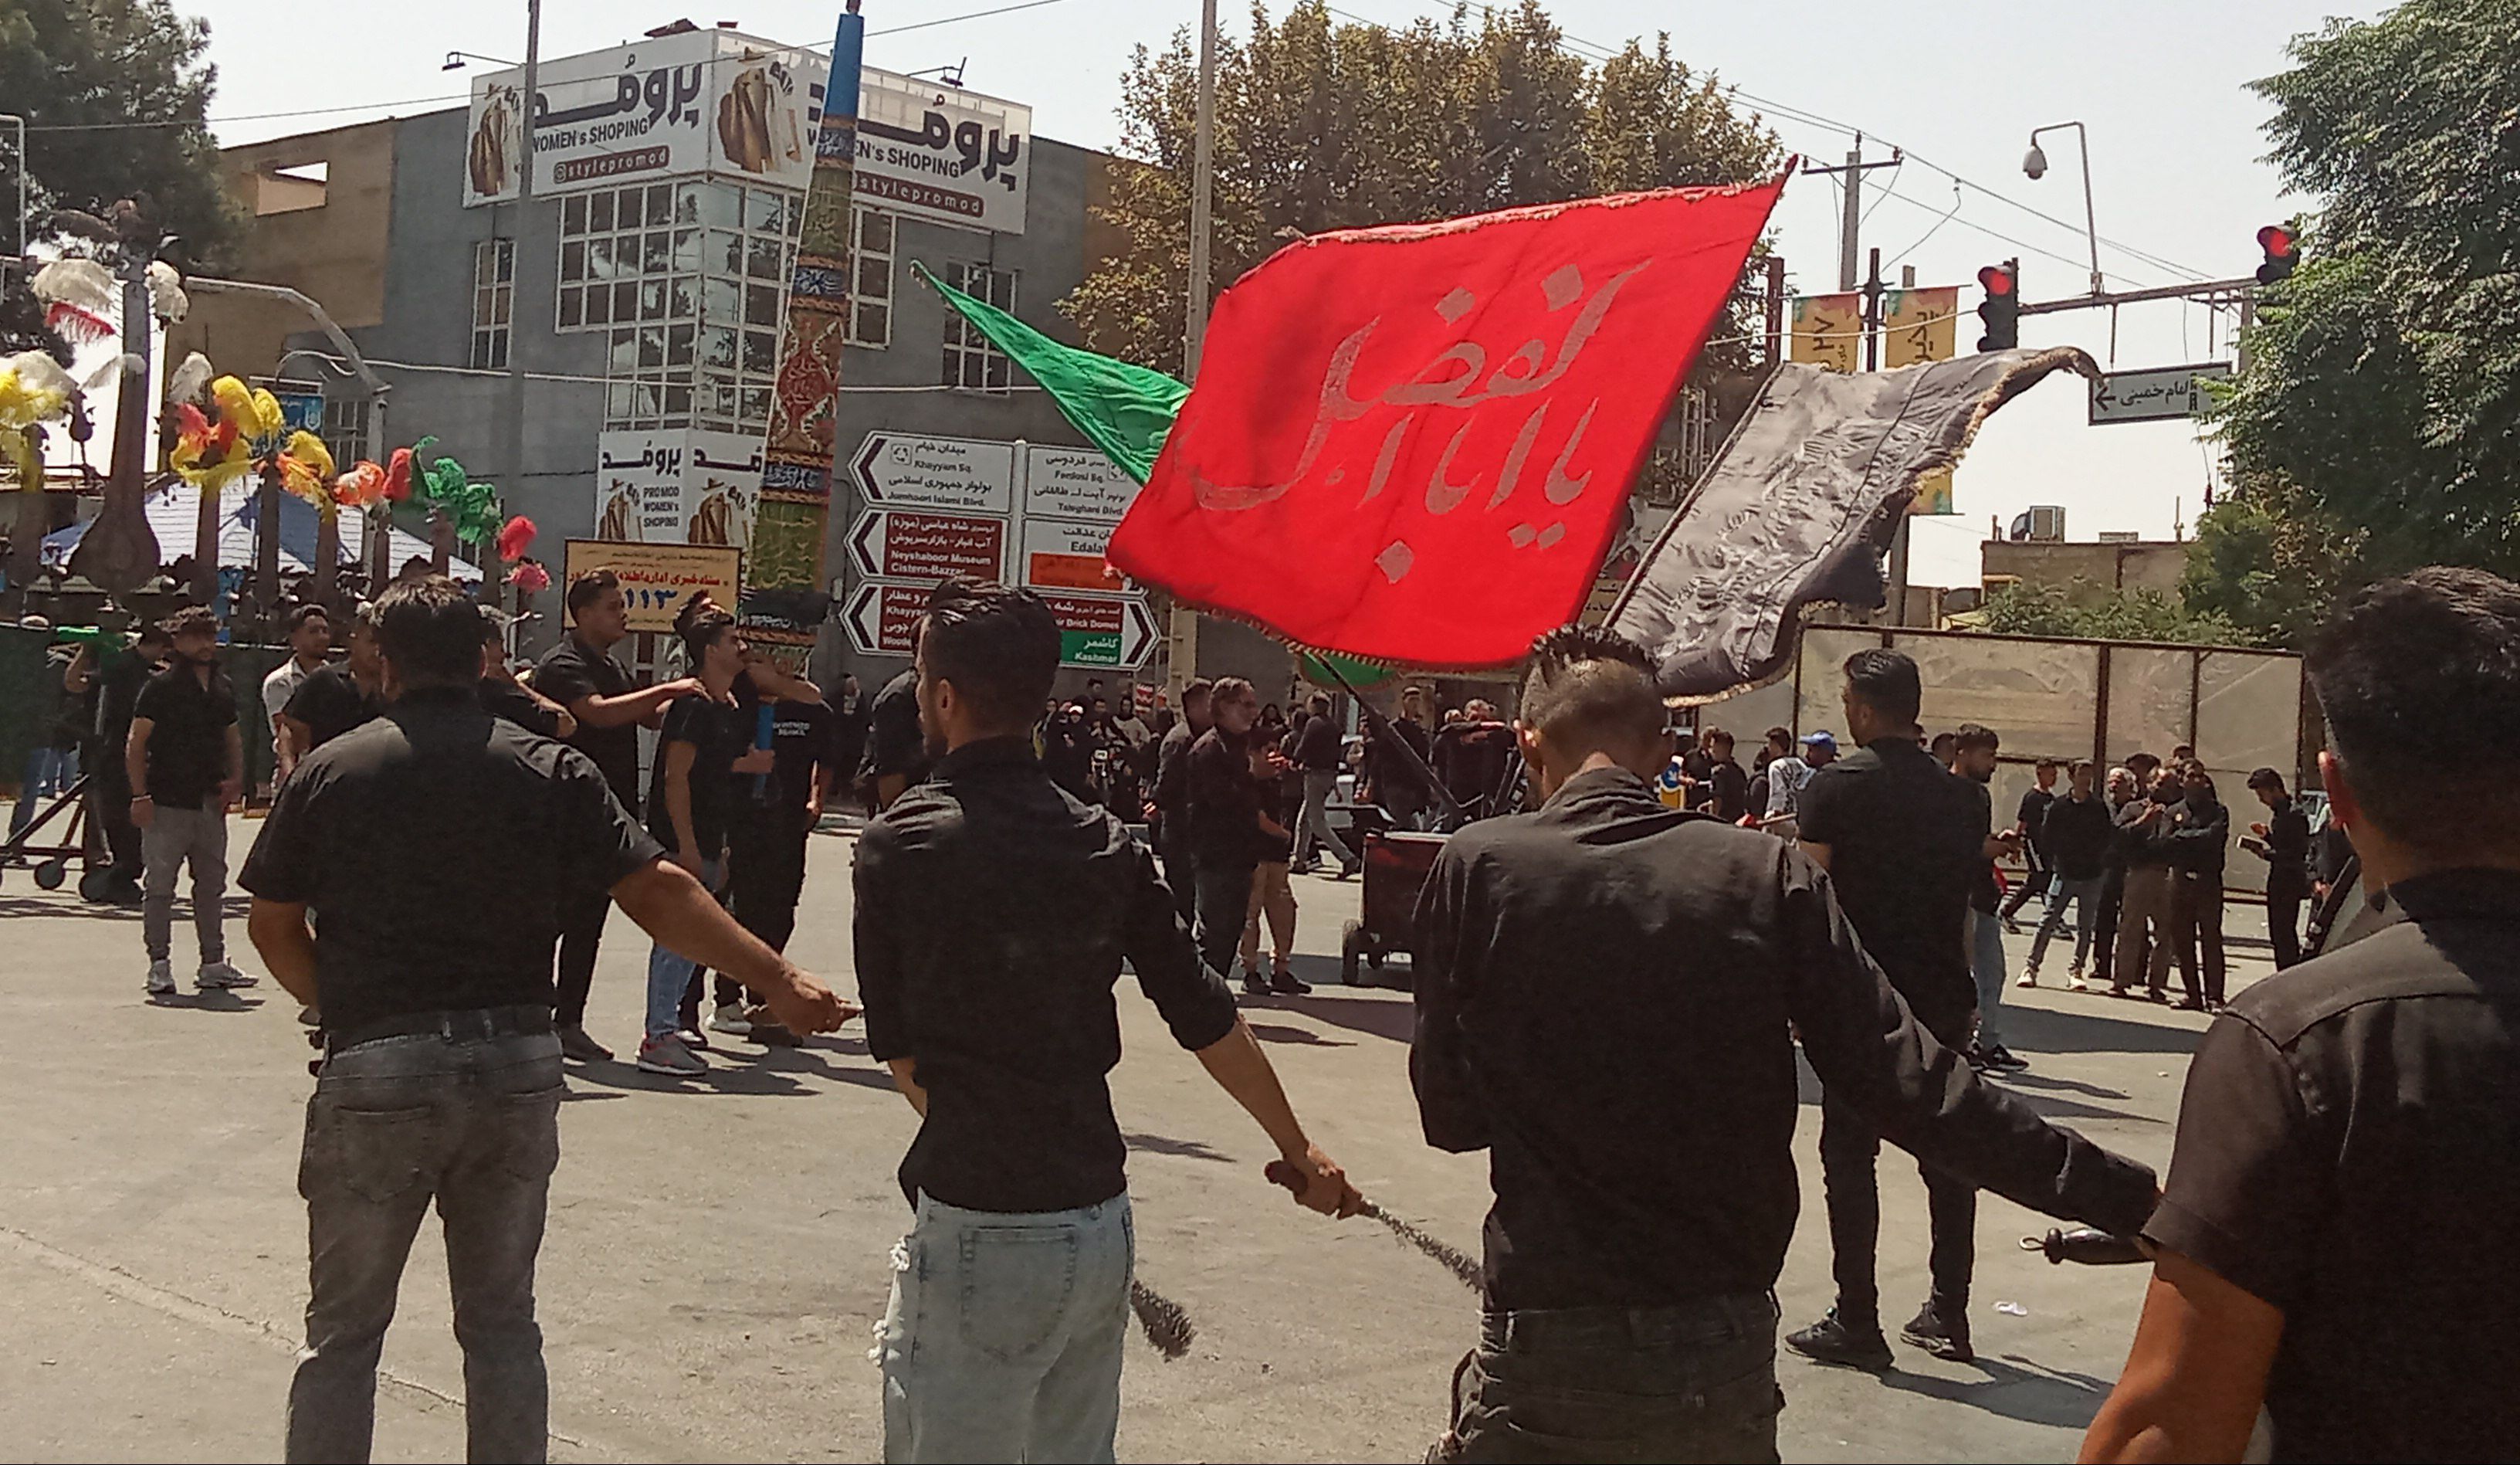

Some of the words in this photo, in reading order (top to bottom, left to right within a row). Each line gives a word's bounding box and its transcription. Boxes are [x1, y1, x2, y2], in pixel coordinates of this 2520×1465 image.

[589, 117, 649, 144] SHOPING
[888, 148, 960, 178] SHOPING
[852, 171, 981, 213] stylepromod
[2120, 384, 2165, 406] خمینی
[2165, 379, 2189, 404] امام
[643, 486, 680, 498] PROMOD
[1070, 541, 1109, 553] Edala
[891, 550, 949, 562] Neyshaboor
[950, 554, 991, 565] Museum
[1066, 618, 1089, 628] Brick
[1089, 619, 1119, 629] Domes
[1083, 637, 1119, 649] کاشمر
[1074, 652, 1119, 663] Kashmar
